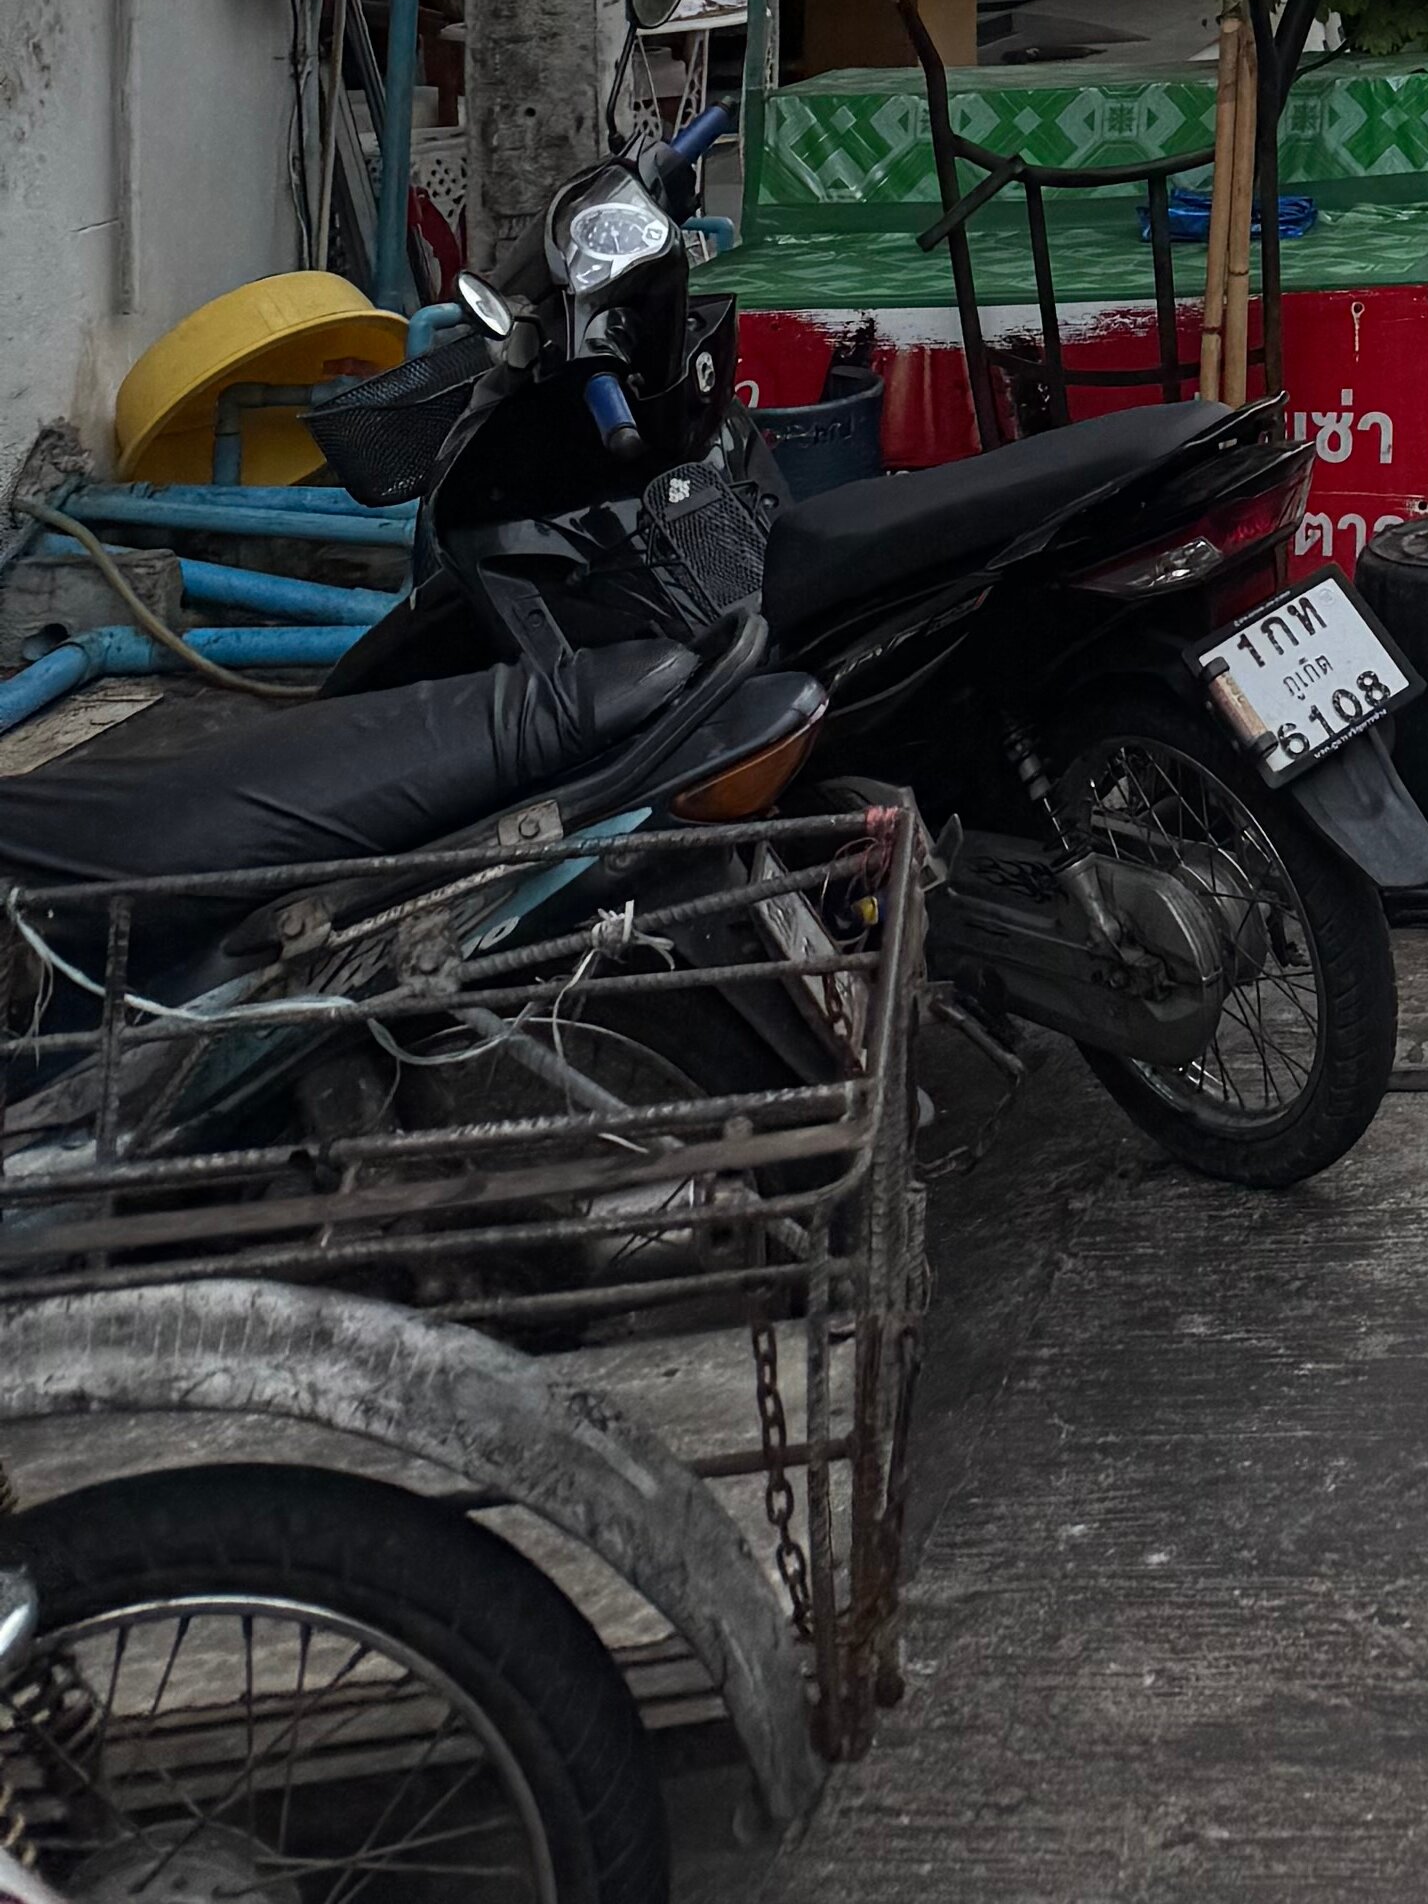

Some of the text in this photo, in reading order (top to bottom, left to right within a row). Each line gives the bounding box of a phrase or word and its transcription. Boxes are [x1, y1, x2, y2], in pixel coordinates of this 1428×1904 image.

[1236, 596, 1328, 668] 1กท
[1282, 654, 1335, 701] ภูเก็ต
[1277, 669, 1392, 760] 6108
